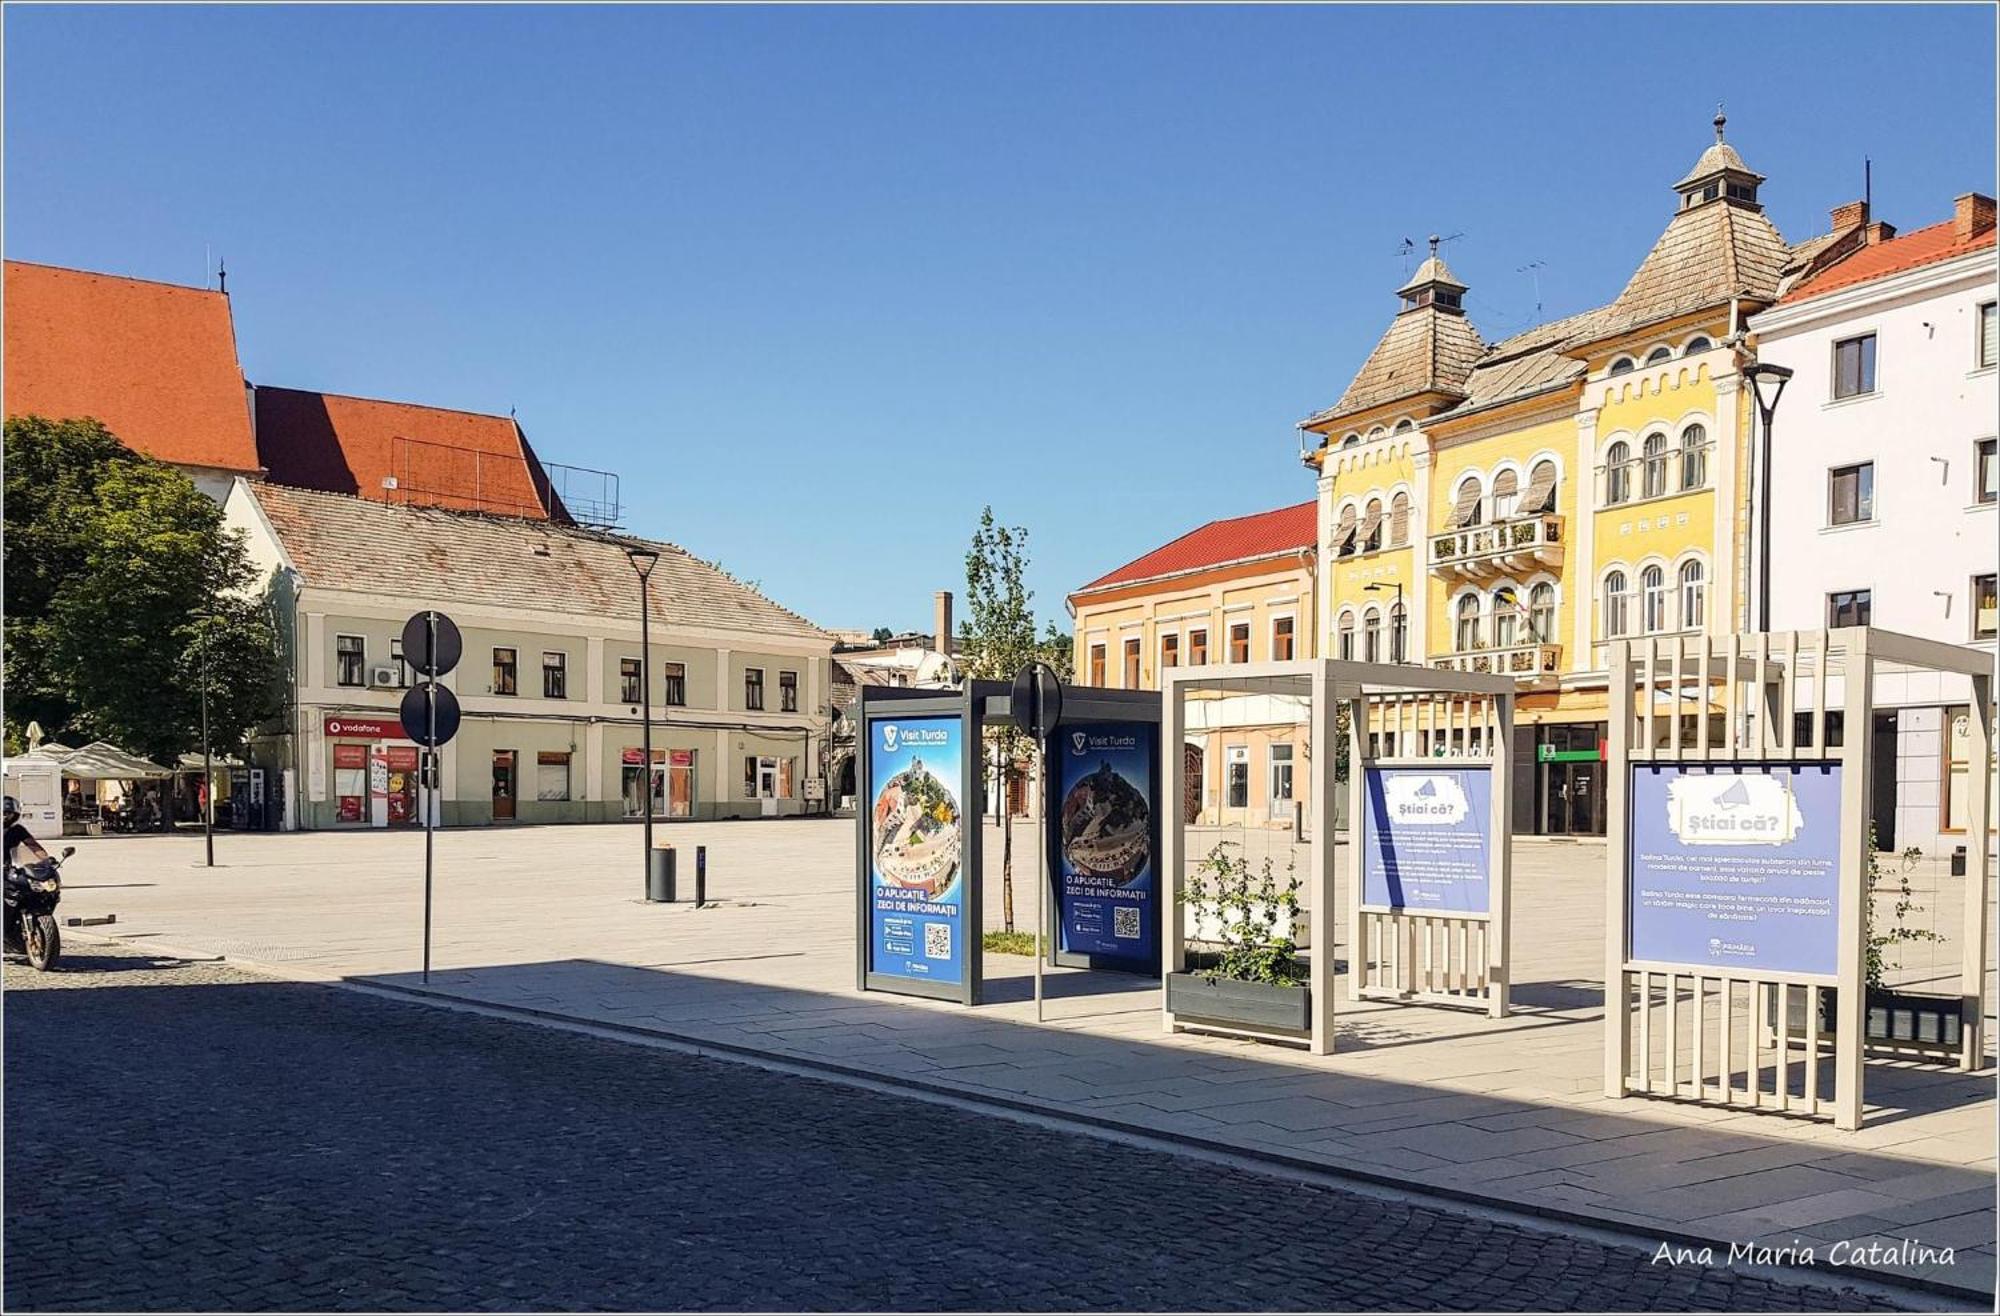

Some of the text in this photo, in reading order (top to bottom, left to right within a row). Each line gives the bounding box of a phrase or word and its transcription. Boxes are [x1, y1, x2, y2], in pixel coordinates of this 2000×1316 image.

[342, 724, 381, 733] vodafone
[900, 729, 948, 740] Visit Turda
[1089, 735, 1136, 746] Visit Turda
[1688, 814, 1779, 834] Știai că?
[1066, 875, 1073, 884] O
[877, 888, 884, 897] O
[1066, 886, 1146, 902] ZECI DE INFORMAȚII
[877, 900, 957, 918] ZECI DE INFORMAȚII
